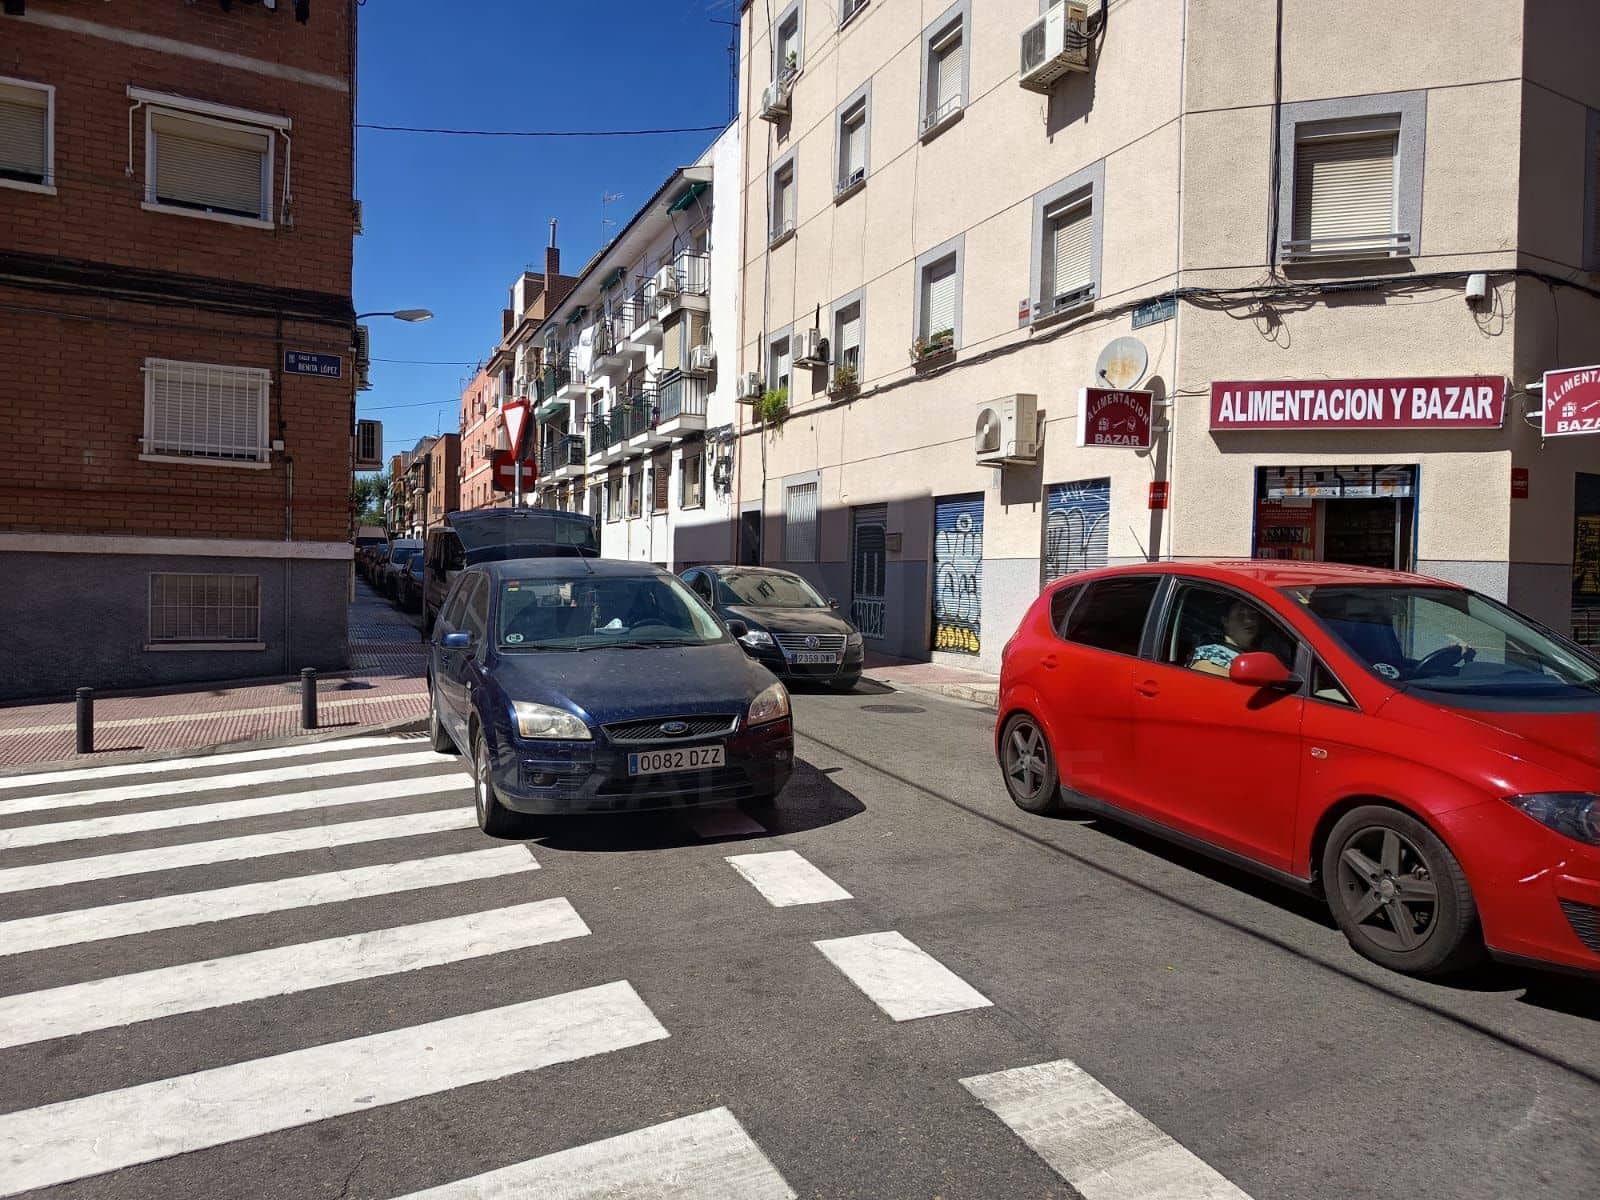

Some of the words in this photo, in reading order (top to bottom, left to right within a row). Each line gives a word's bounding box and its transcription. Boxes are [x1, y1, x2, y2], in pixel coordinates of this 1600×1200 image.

[298, 362, 318, 373] BENITA
[1087, 392, 1149, 425] ALIMENTACION
[1217, 387, 1383, 422] ALIMENTACION
[1390, 387, 1407, 420] Y
[1411, 386, 1494, 420] BAZAR
[1094, 433, 1140, 446] BAZAR
[640, 752, 684, 771] 0082
[689, 748, 721, 767] DZZ
